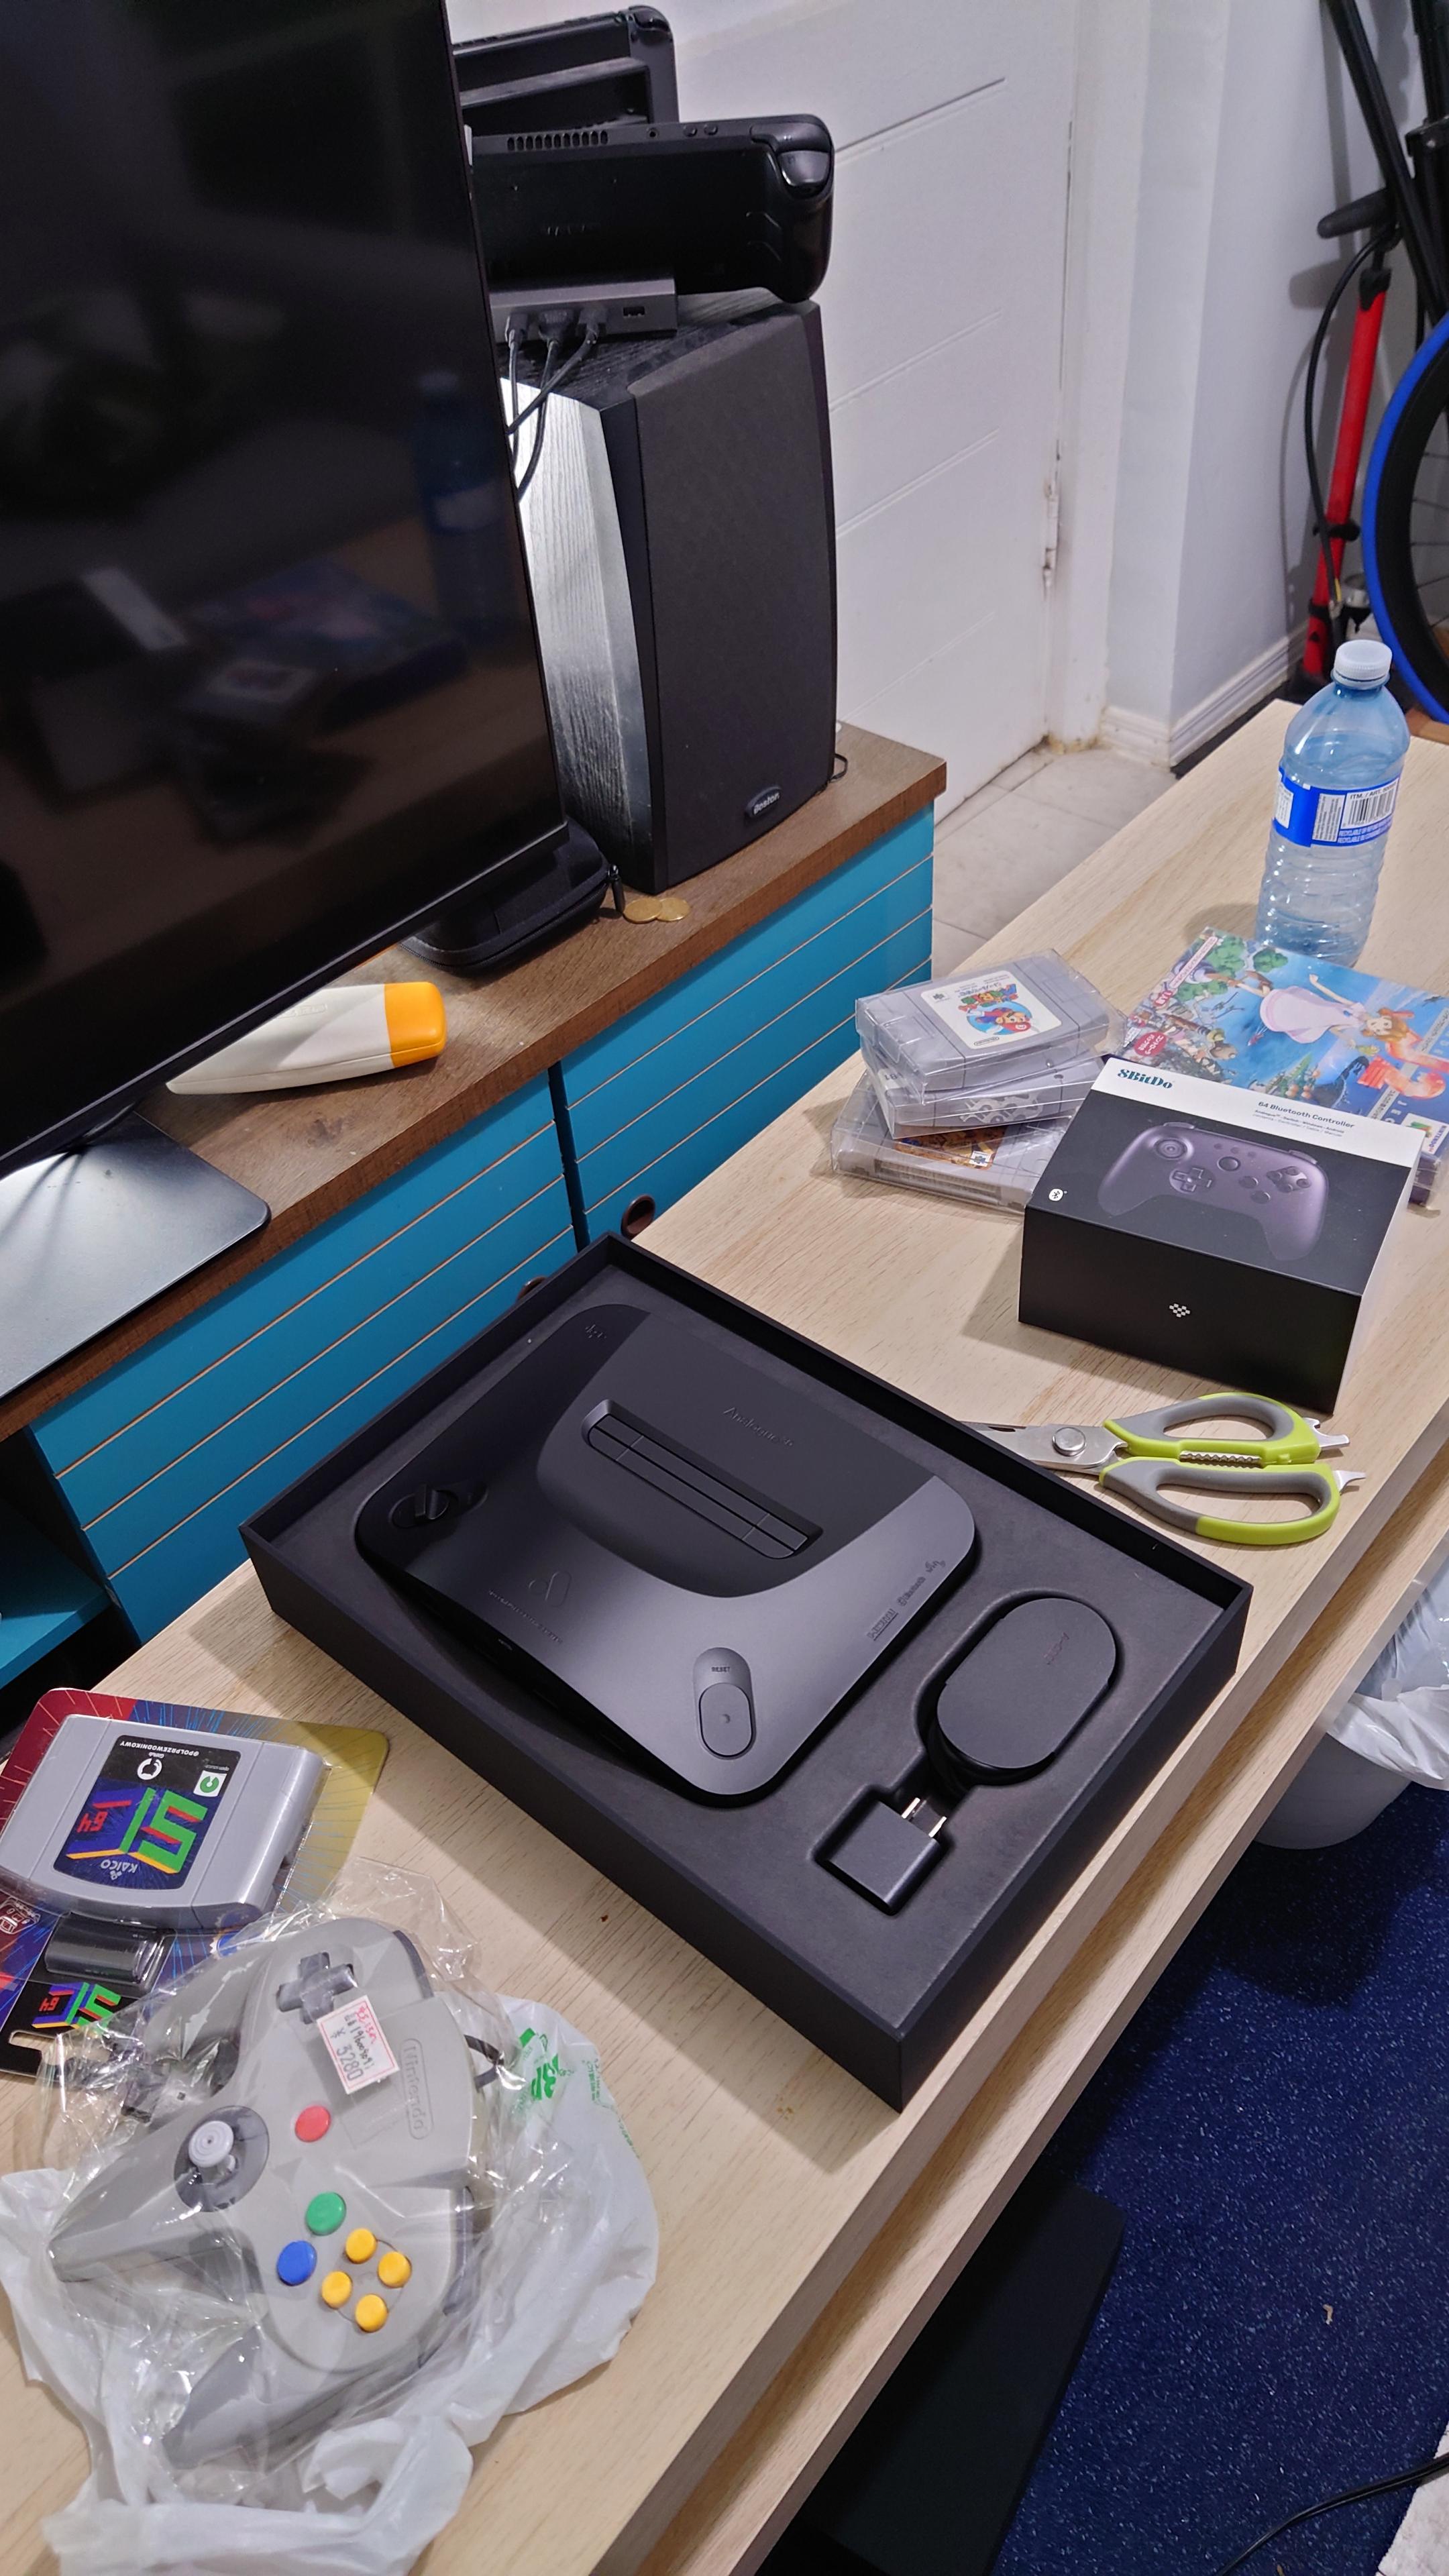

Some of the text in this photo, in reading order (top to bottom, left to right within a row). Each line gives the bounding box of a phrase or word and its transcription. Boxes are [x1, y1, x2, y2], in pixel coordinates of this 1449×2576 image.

[753, 792, 780, 815] Boston
[1118, 1069, 1173, 1089] 8BitDo
[1269, 1104, 1311, 1119] Bluetooth
[1312, 1114, 1355, 1128] Controller
[722, 1407, 779, 1442] Analogue
[119, 1740, 199, 1757] @POLPRZEWODNIKOWY
[77, 1811, 108, 1833] 64
[101, 1859, 138, 1873] KAICO
[39, 1996, 60, 2011] 64
[336, 2044, 364, 2081] 3280
[404, 2046, 427, 2130] Nintendo
